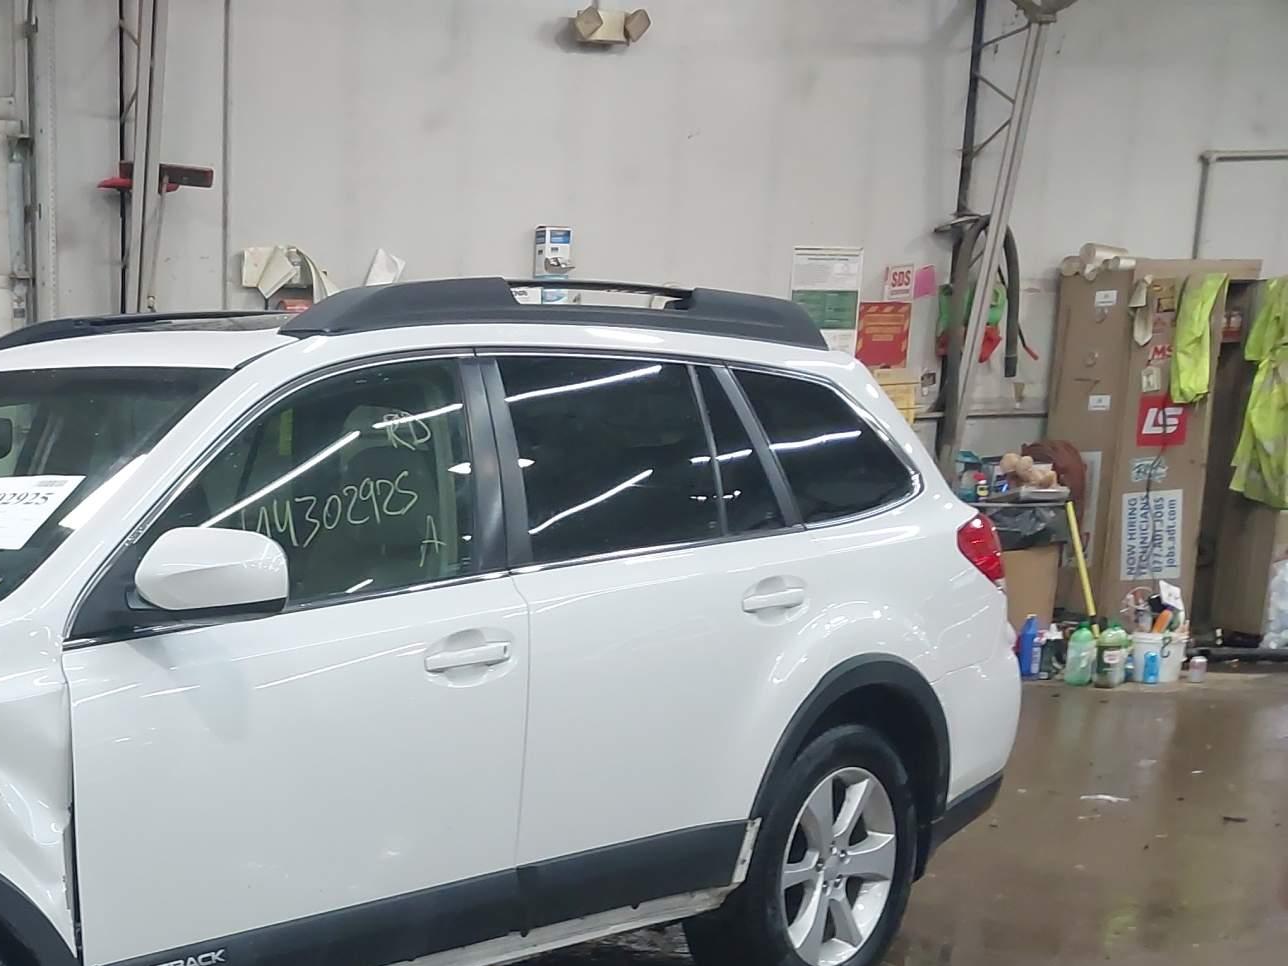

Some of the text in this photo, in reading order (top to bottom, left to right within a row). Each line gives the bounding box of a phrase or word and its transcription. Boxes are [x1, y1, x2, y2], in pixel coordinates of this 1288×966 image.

[891, 270, 911, 288] SDS
[419, 515, 446, 568] A
[1126, 498, 1137, 576] NOW HIRING
[1138, 495, 1150, 576] TECHNICIANS
[1165, 499, 1177, 568] jobs.adt.com
